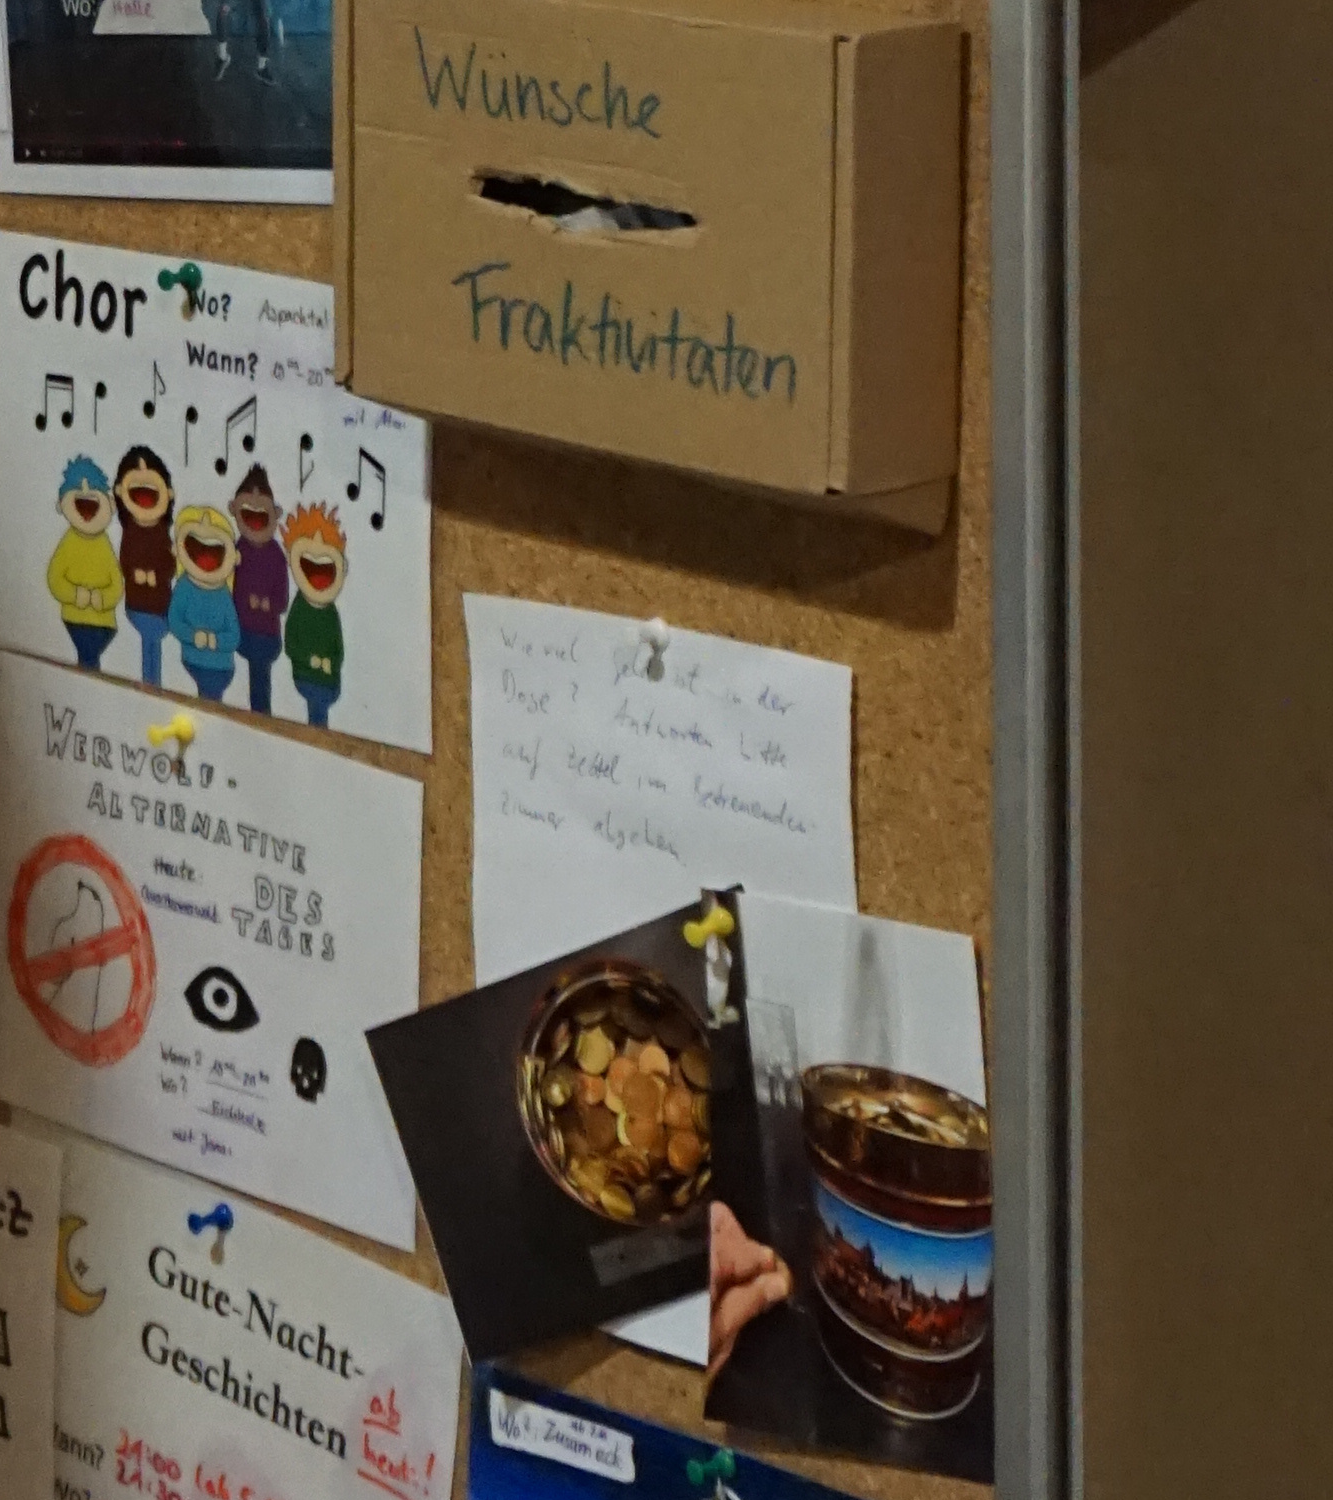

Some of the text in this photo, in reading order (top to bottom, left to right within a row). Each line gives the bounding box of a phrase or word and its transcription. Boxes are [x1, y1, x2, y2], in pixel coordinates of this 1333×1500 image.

[412, 24, 665, 140] Wünsche
[19, 249, 148, 339] Chor
[188, 287, 232, 322] Wo?
[185, 339, 259, 380] Wann?
[85, 779, 310, 876] ALTERNATIVE
[253, 872, 324, 927] DES
[145, 1244, 367, 1381] Gute-Nacht-
[139, 1319, 347, 1461] Geschichten
